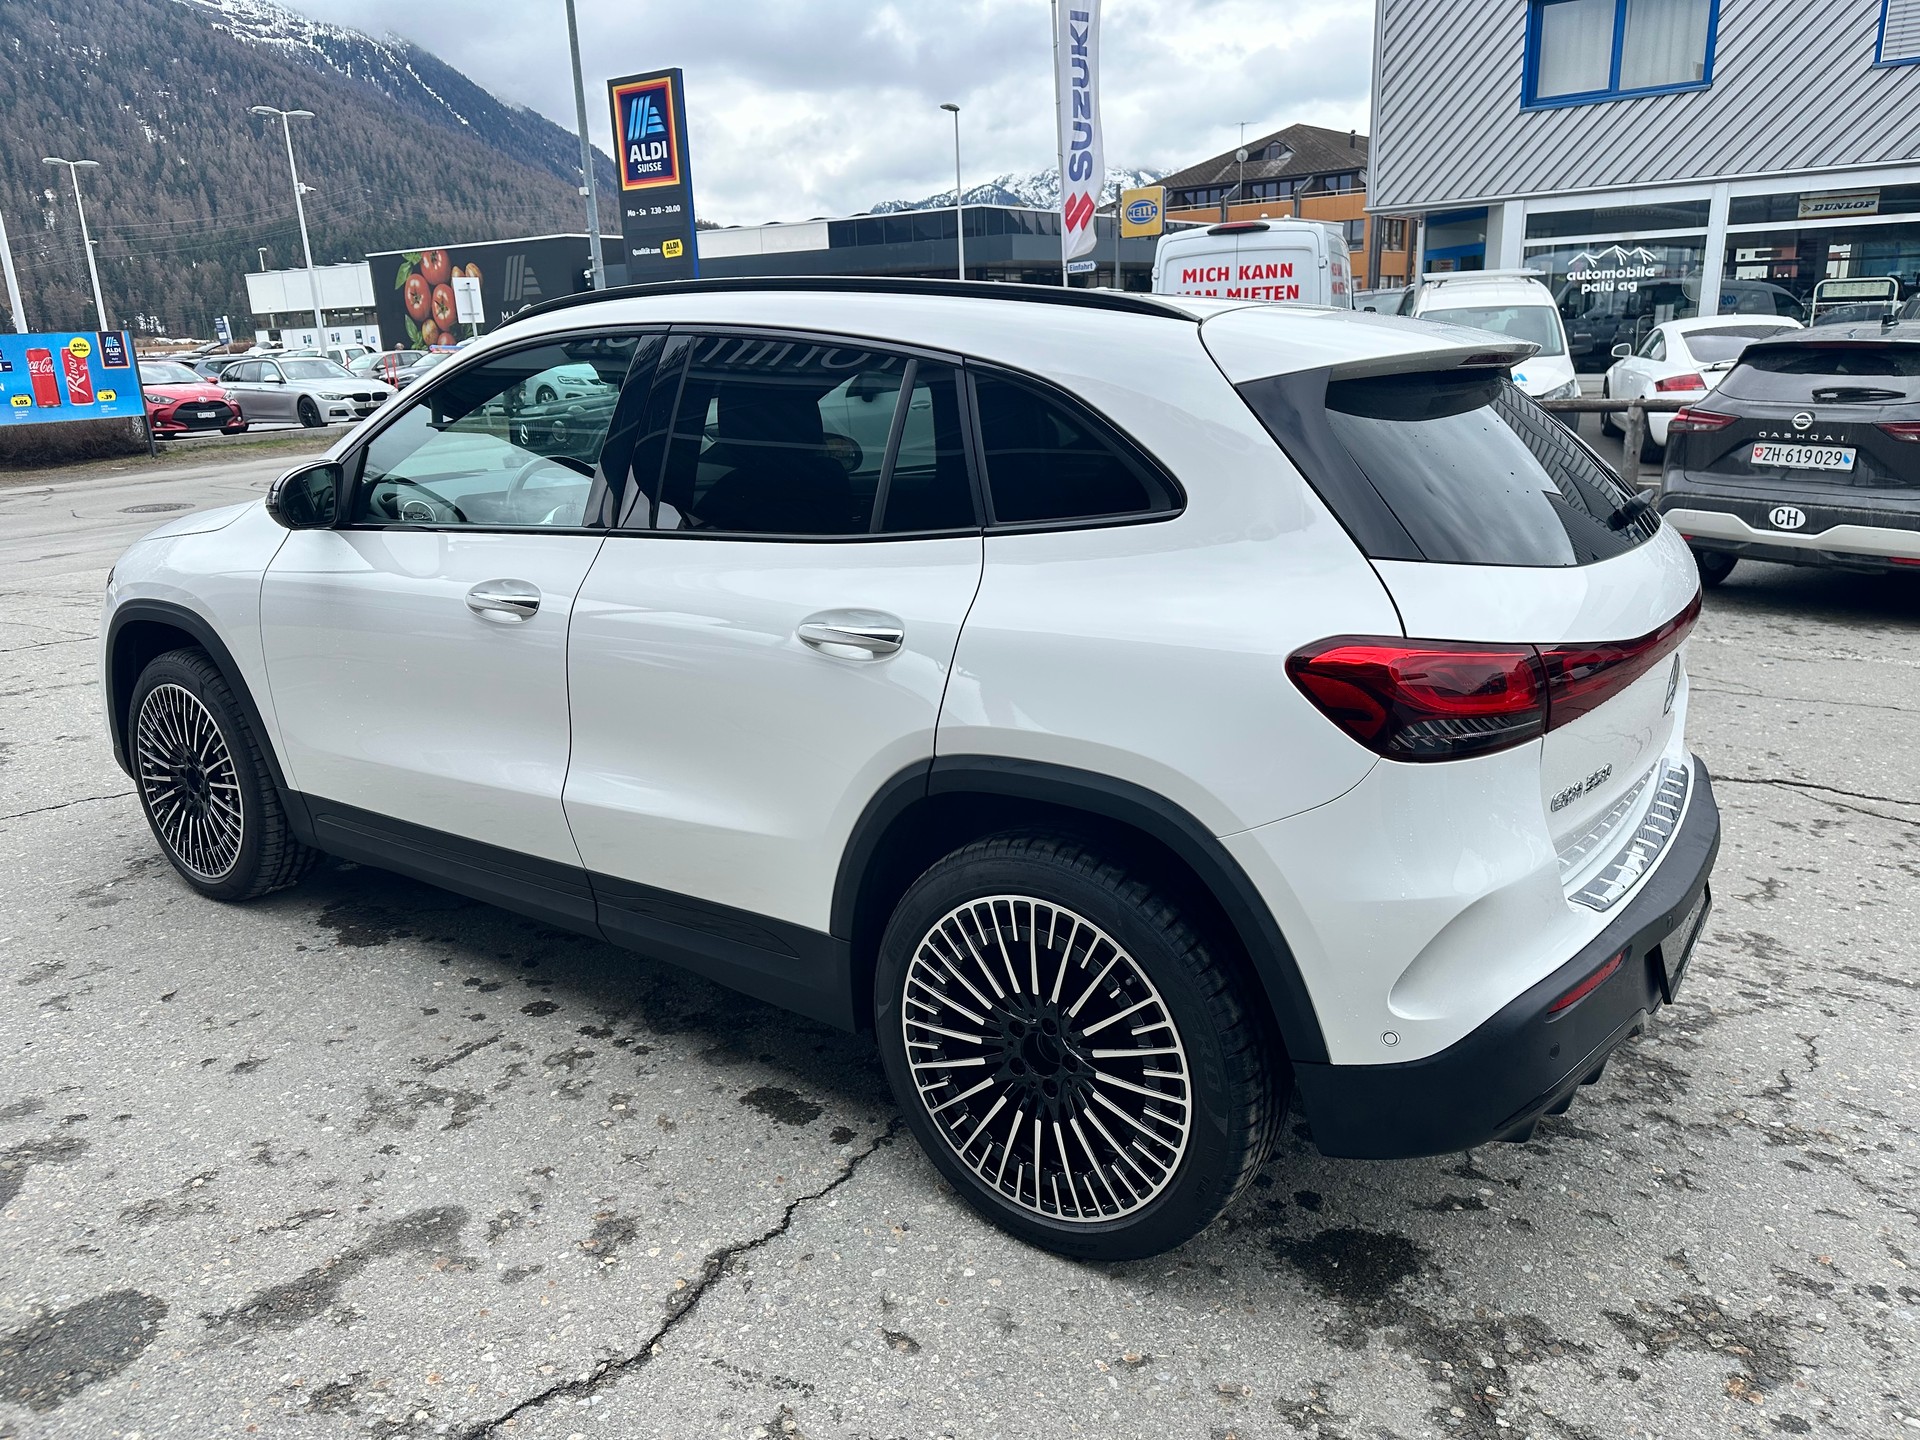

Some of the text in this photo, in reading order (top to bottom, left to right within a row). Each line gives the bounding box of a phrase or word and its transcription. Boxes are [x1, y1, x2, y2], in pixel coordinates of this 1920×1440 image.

[1068, 9, 1094, 183] SUZUKI
[629, 140, 668, 163] ALDI
[637, 161, 663, 173] SUISSE
[627, 209, 636, 217] Mo
[639, 208, 647, 216] Sa
[650, 206, 662, 215] 7.30
[665, 204, 681, 213] 20.00
[1128, 205, 1159, 218] HELLA
[1812, 200, 1876, 212] DUNLOP
[666, 241, 680, 250] ALDI
[1069, 262, 1094, 272] Einfahrt
[1182, 262, 1293, 284] MICH KANN
[1566, 265, 1656, 281] automobile
[1580, 280, 1638, 295] palü ag
[1758, 431, 1845, 441] QASHQAI
[1774, 508, 1799, 527] CH
